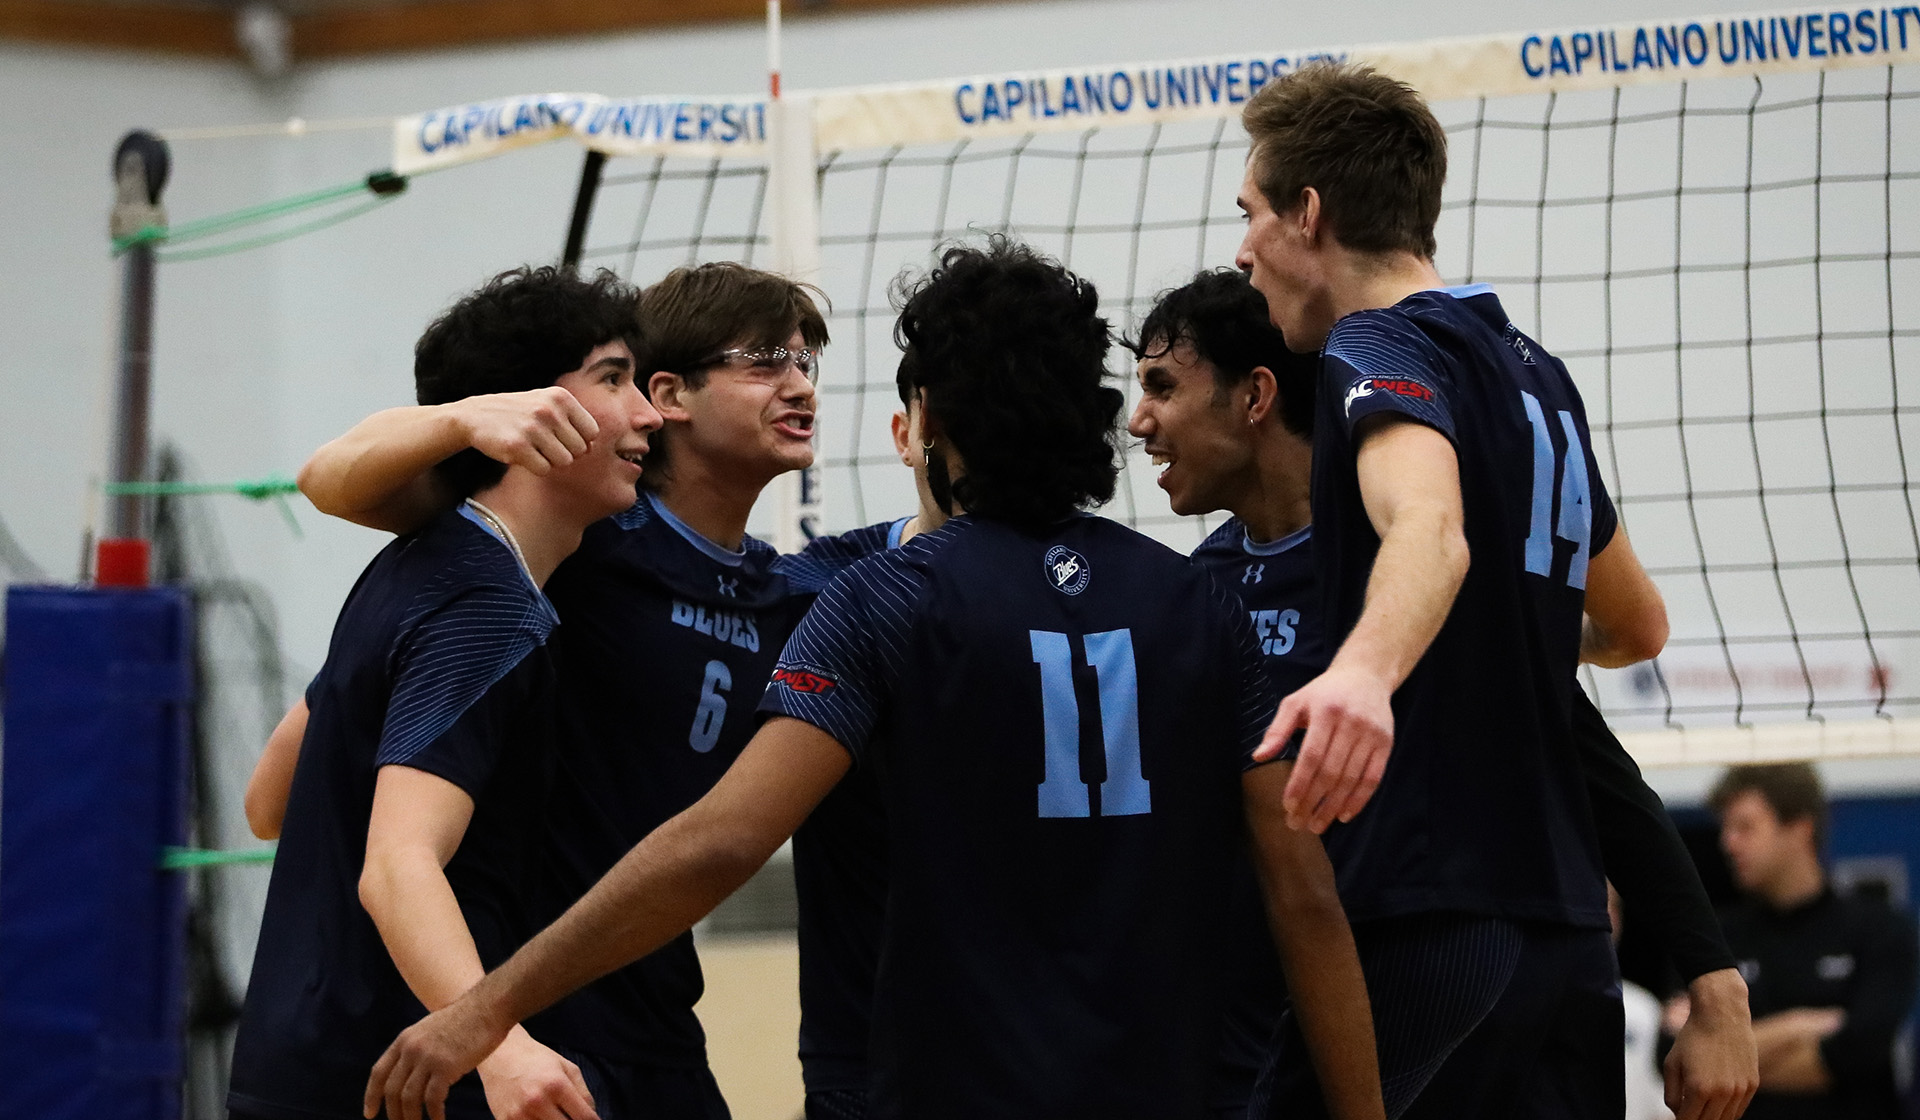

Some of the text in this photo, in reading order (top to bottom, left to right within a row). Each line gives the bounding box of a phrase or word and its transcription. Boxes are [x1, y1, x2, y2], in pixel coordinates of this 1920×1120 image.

[1521, 6, 1920, 78] CAPILANO UNIVERSIT
[954, 54, 1347, 124] CAPILANO UNIVER
[418, 101, 765, 153] CAPILANO UNIVERSIT
[1520, 390, 1593, 591] 14
[671, 600, 760, 653] BLUES
[688, 659, 732, 753] 6
[771, 669, 836, 693] WEST
[1029, 628, 1151, 818] 11
